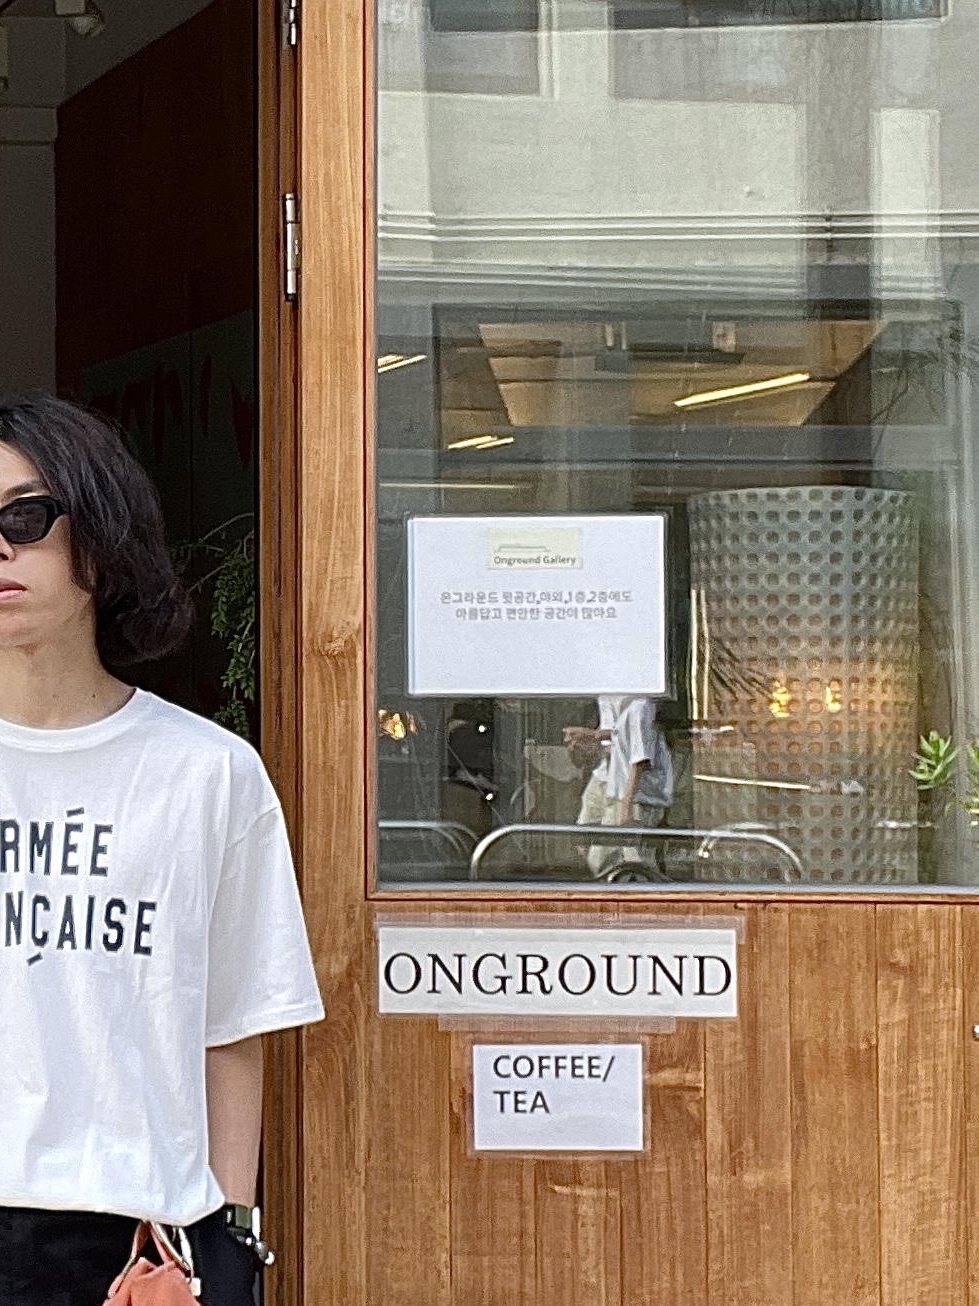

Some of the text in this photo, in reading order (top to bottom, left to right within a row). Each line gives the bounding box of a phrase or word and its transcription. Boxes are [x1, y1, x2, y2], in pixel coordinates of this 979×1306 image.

[494, 555, 576, 566] Onground Gallery
[383, 951, 733, 997] ONGROUND
[493, 1054, 616, 1083] COFFEE/
[494, 1090, 550, 1114] TEA
